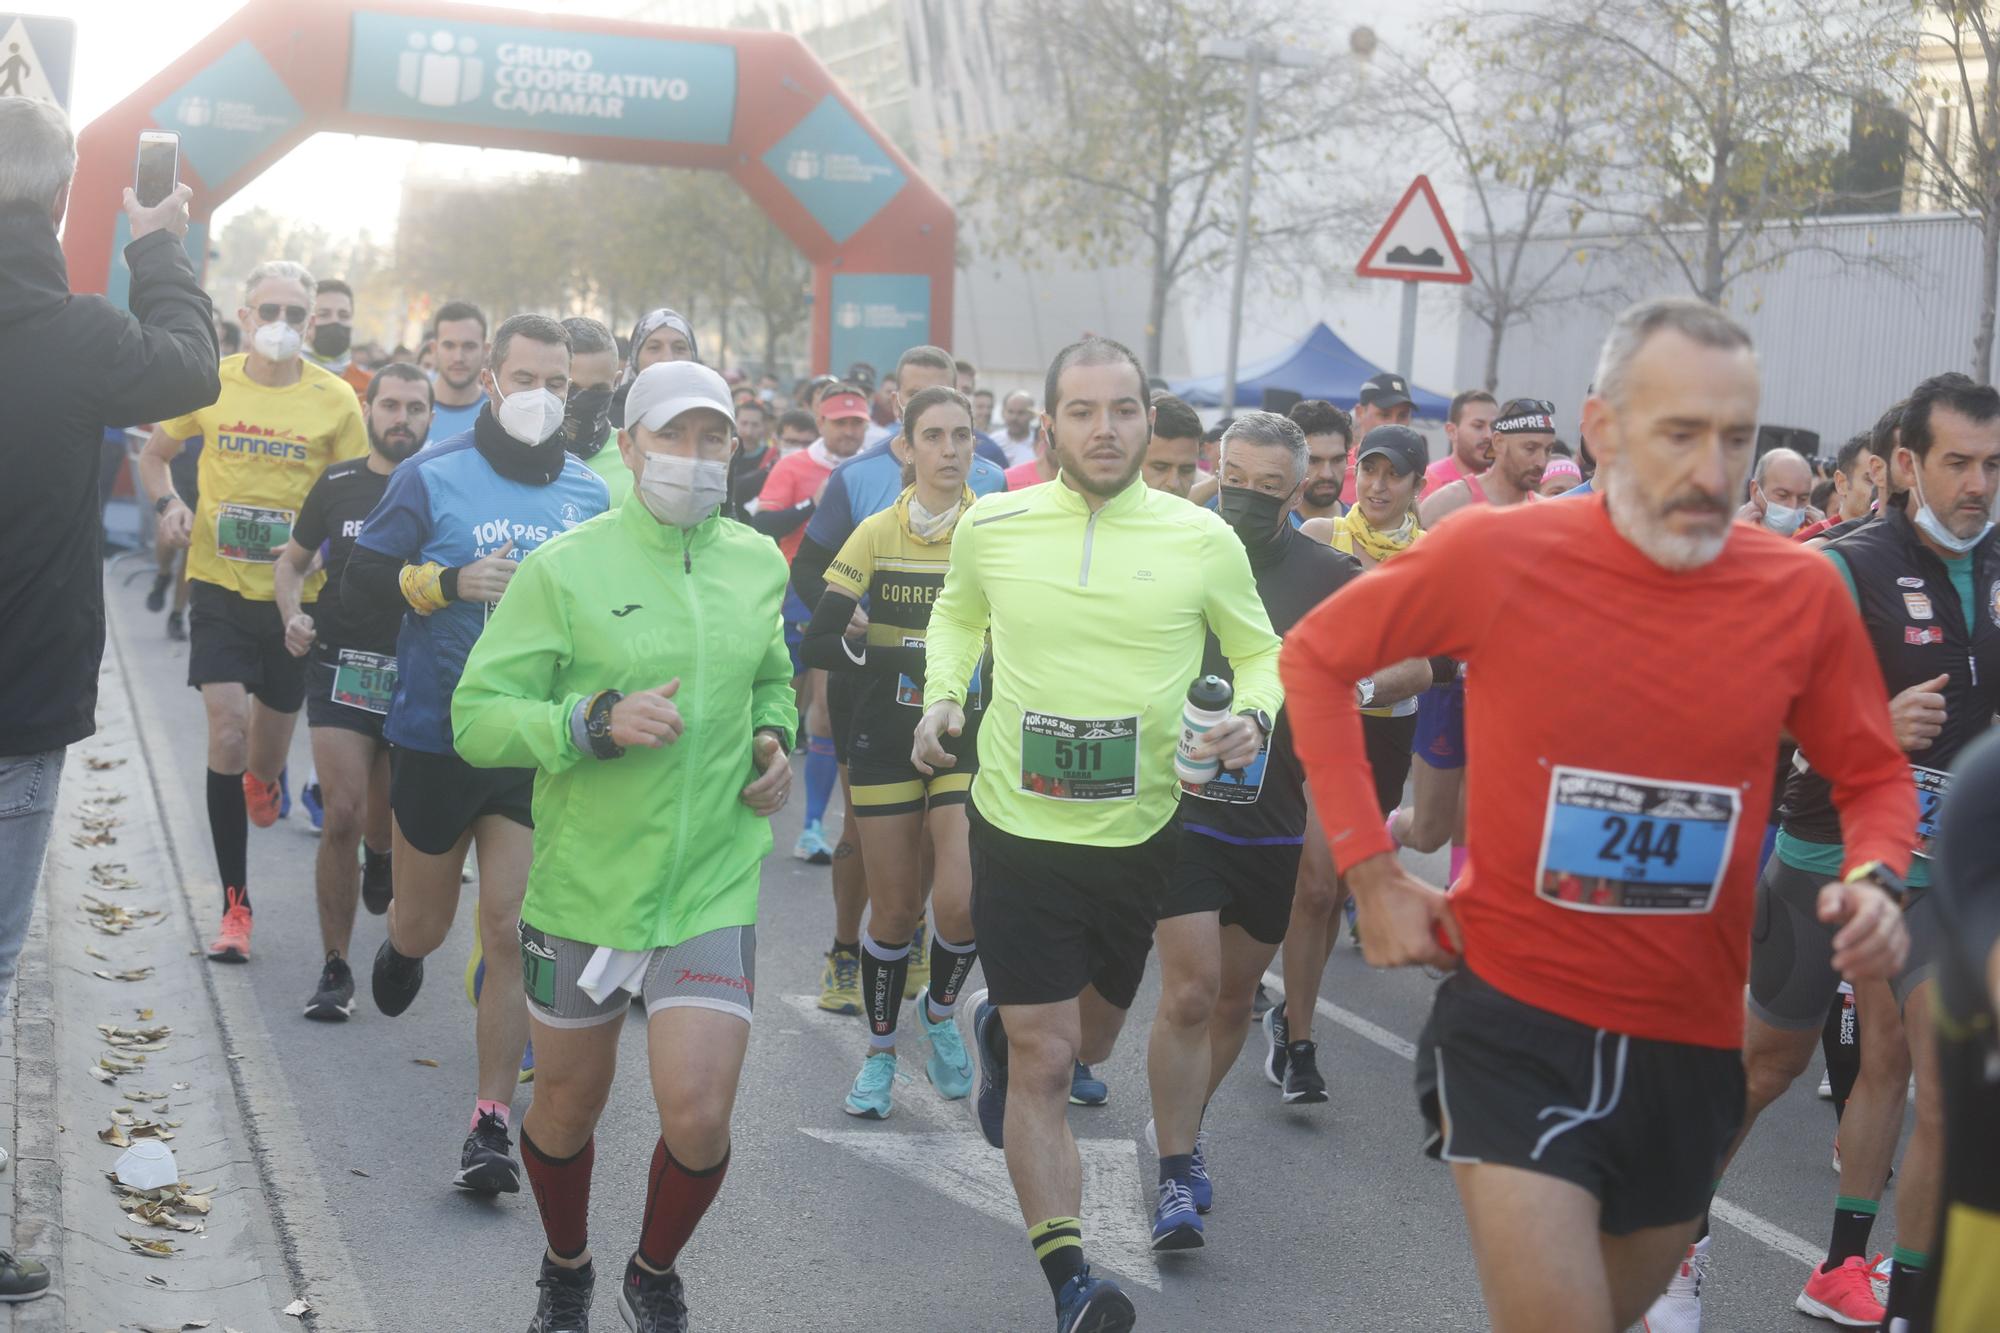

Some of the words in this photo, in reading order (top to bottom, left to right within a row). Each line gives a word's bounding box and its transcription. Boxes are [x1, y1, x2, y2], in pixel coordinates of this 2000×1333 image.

[495, 43, 593, 71] GRUPO
[494, 66, 690, 101] COOPERATIVO
[492, 88, 624, 119] CAJAMAR
[218, 435, 306, 460] runners
[236, 521, 271, 543] 503
[472, 518, 512, 547] 10K
[512, 524, 548, 542] PAS
[1041, 717, 1058, 727] PAS
[1055, 740, 1102, 771] 511
[1598, 816, 1681, 867] 244
[1840, 1008, 1849, 1045] COMPRE
[1846, 1015, 1854, 1045] SPORT
